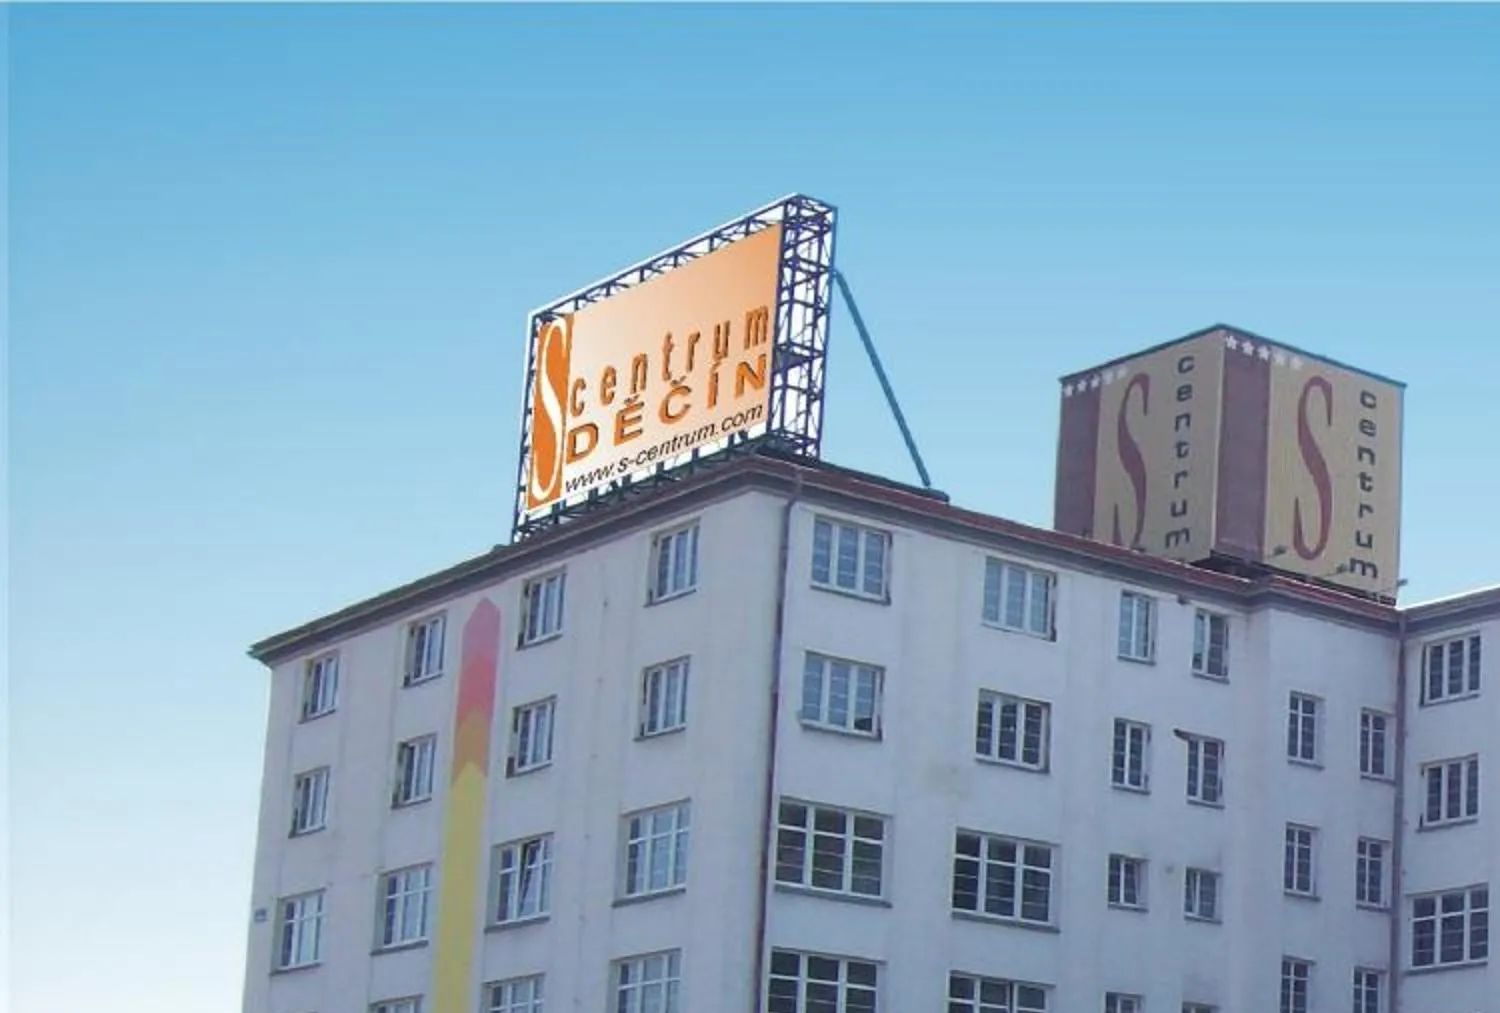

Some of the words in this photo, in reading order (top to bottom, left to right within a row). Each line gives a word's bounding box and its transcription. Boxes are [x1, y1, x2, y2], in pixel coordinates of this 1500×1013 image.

[565, 353, 767, 466] DĚČÍN
[569, 305, 770, 418] centrum
[564, 403, 764, 494] www.s-centrum.com
[1164, 355, 1195, 549] centrum
[1293, 375, 1334, 561] S
[1348, 389, 1379, 580] centrum
